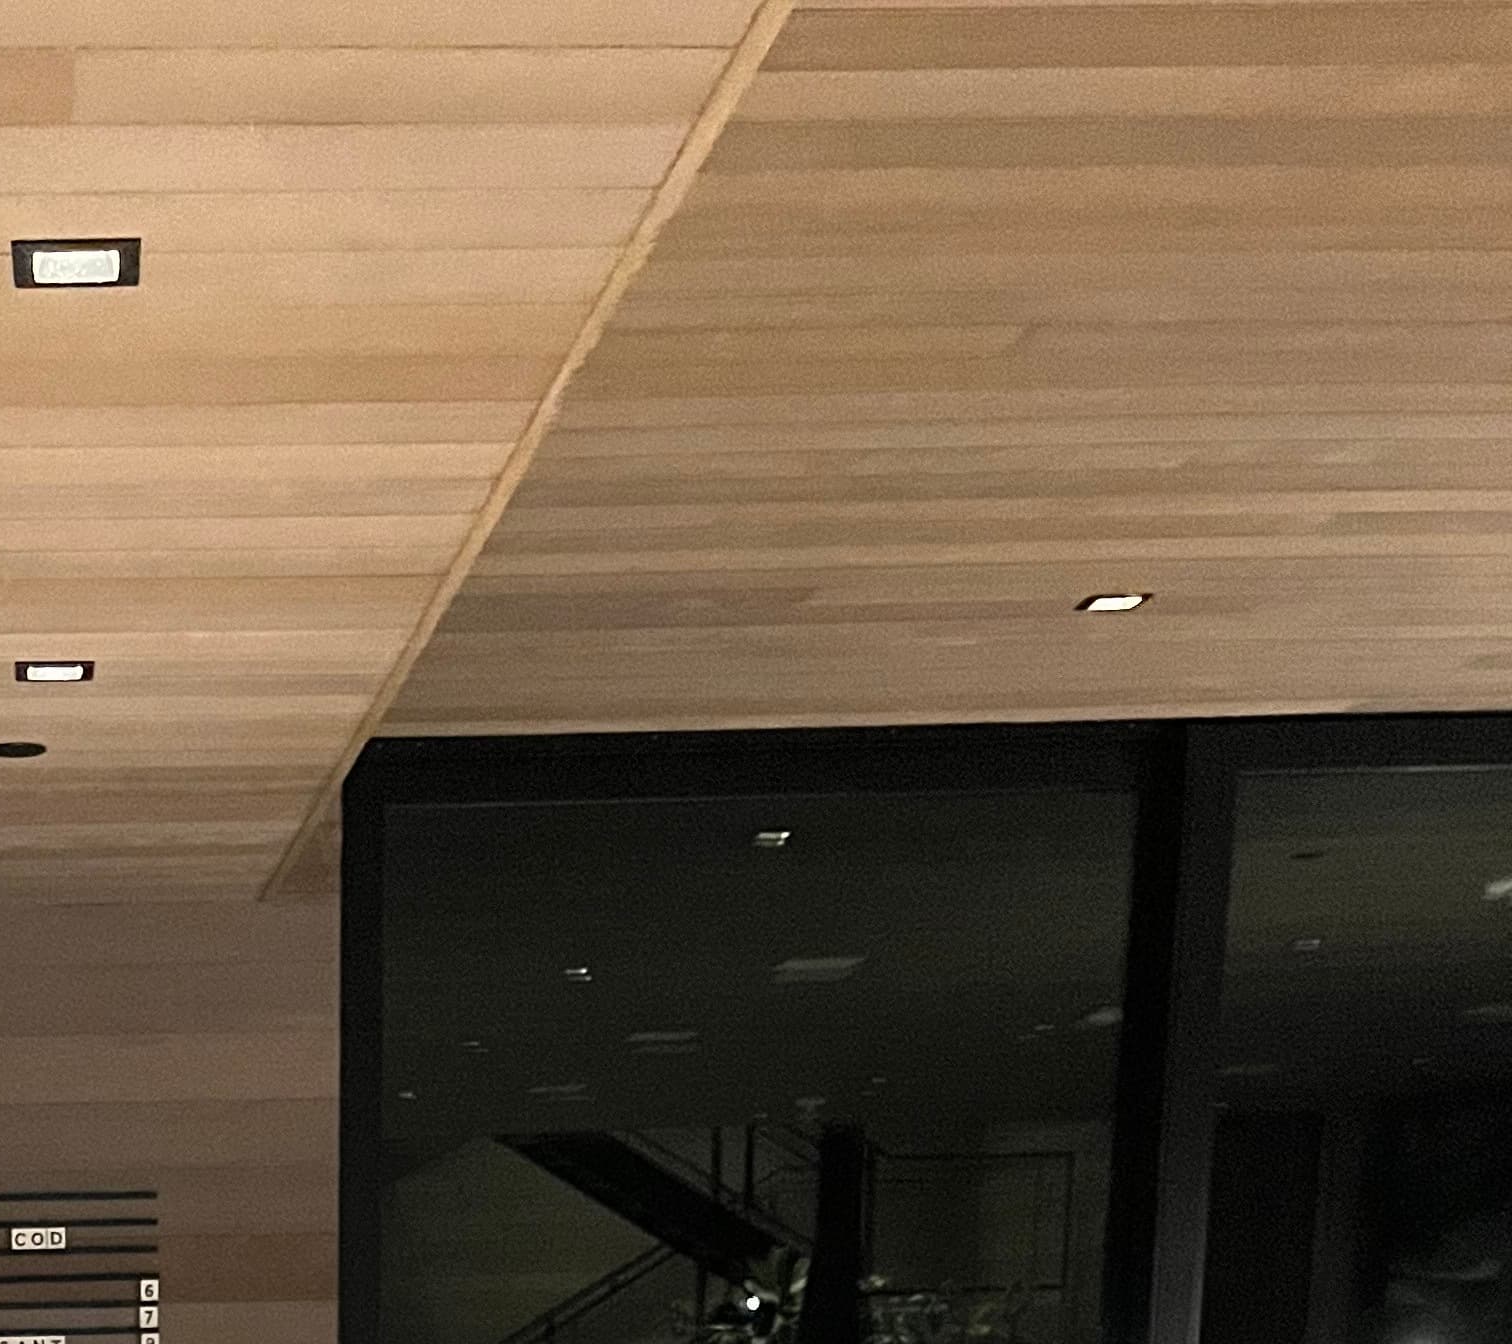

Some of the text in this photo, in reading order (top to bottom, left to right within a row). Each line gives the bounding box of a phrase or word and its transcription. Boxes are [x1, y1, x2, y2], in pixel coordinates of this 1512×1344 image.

[14, 1231, 63, 1246] COD
[145, 1284, 154, 1298] 6
[145, 1311, 153, 1326] 7
